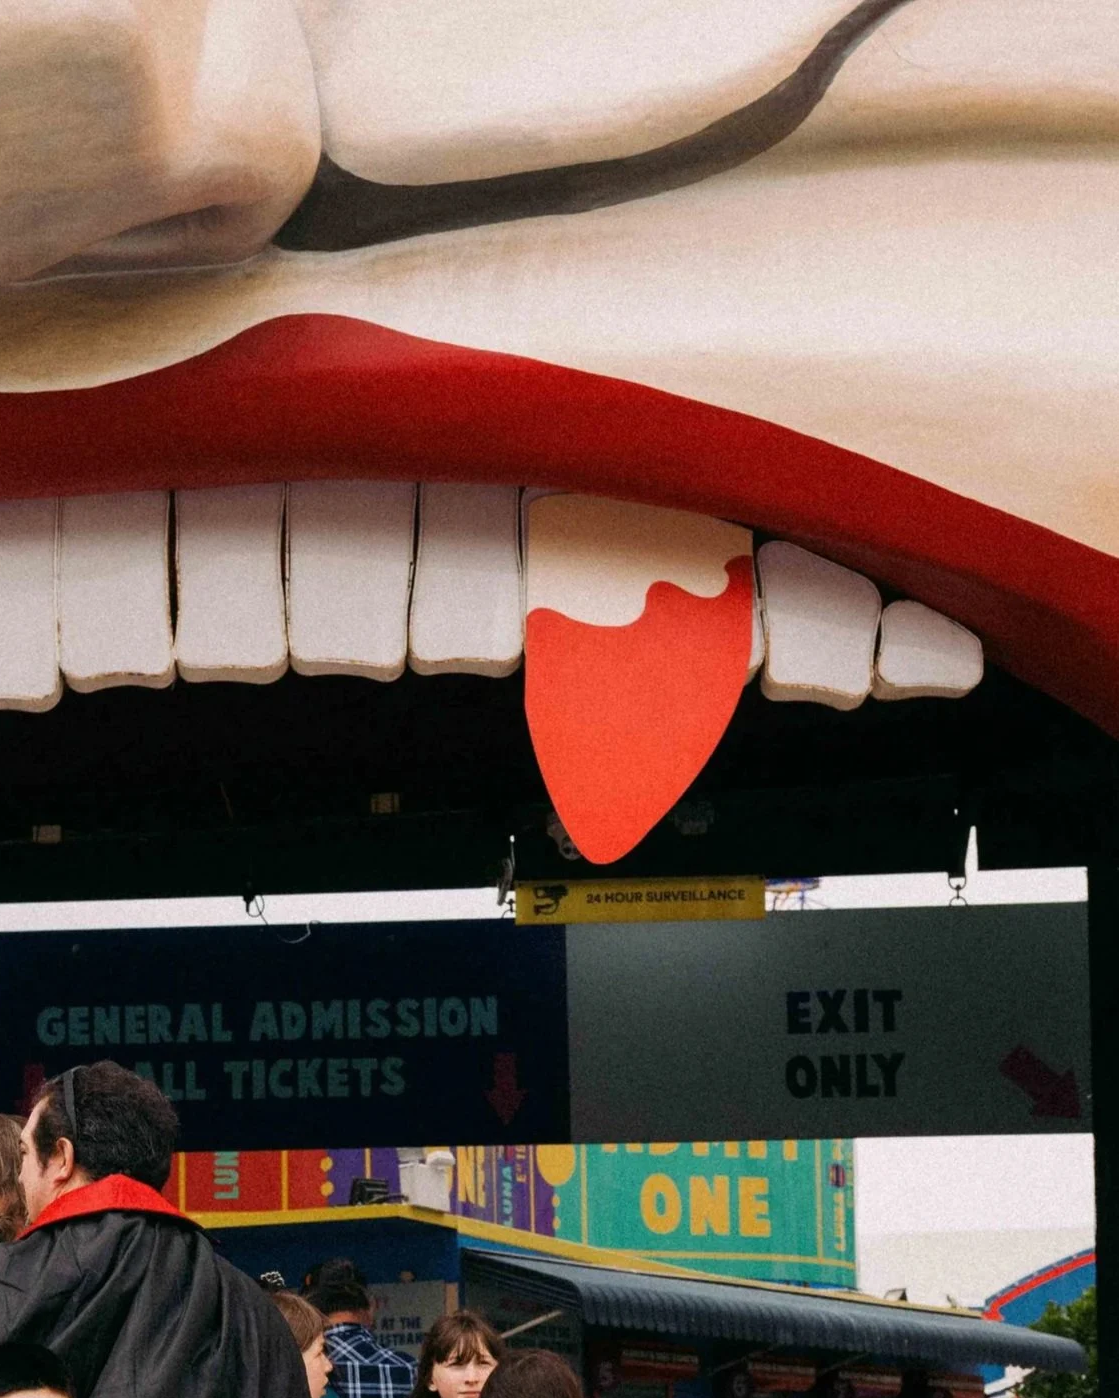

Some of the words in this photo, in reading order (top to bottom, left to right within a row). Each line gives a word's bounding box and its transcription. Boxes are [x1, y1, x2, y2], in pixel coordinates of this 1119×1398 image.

[586, 893, 602, 905] 24
[604, 891, 644, 904] HOUR
[645, 888, 746, 903] SURVEILLANCE
[35, 1003, 233, 1047] GENERAL
[248, 996, 499, 1043] ADMISSION
[785, 988, 903, 1035] EXIT
[222, 1056, 407, 1101] TICKETS
[785, 1052, 906, 1100] ONLY
[501, 1165, 514, 1227] LUNA
[639, 1172, 773, 1238] ONE
[381, 1316, 395, 1330] AT
[399, 1315, 422, 1330] THE
